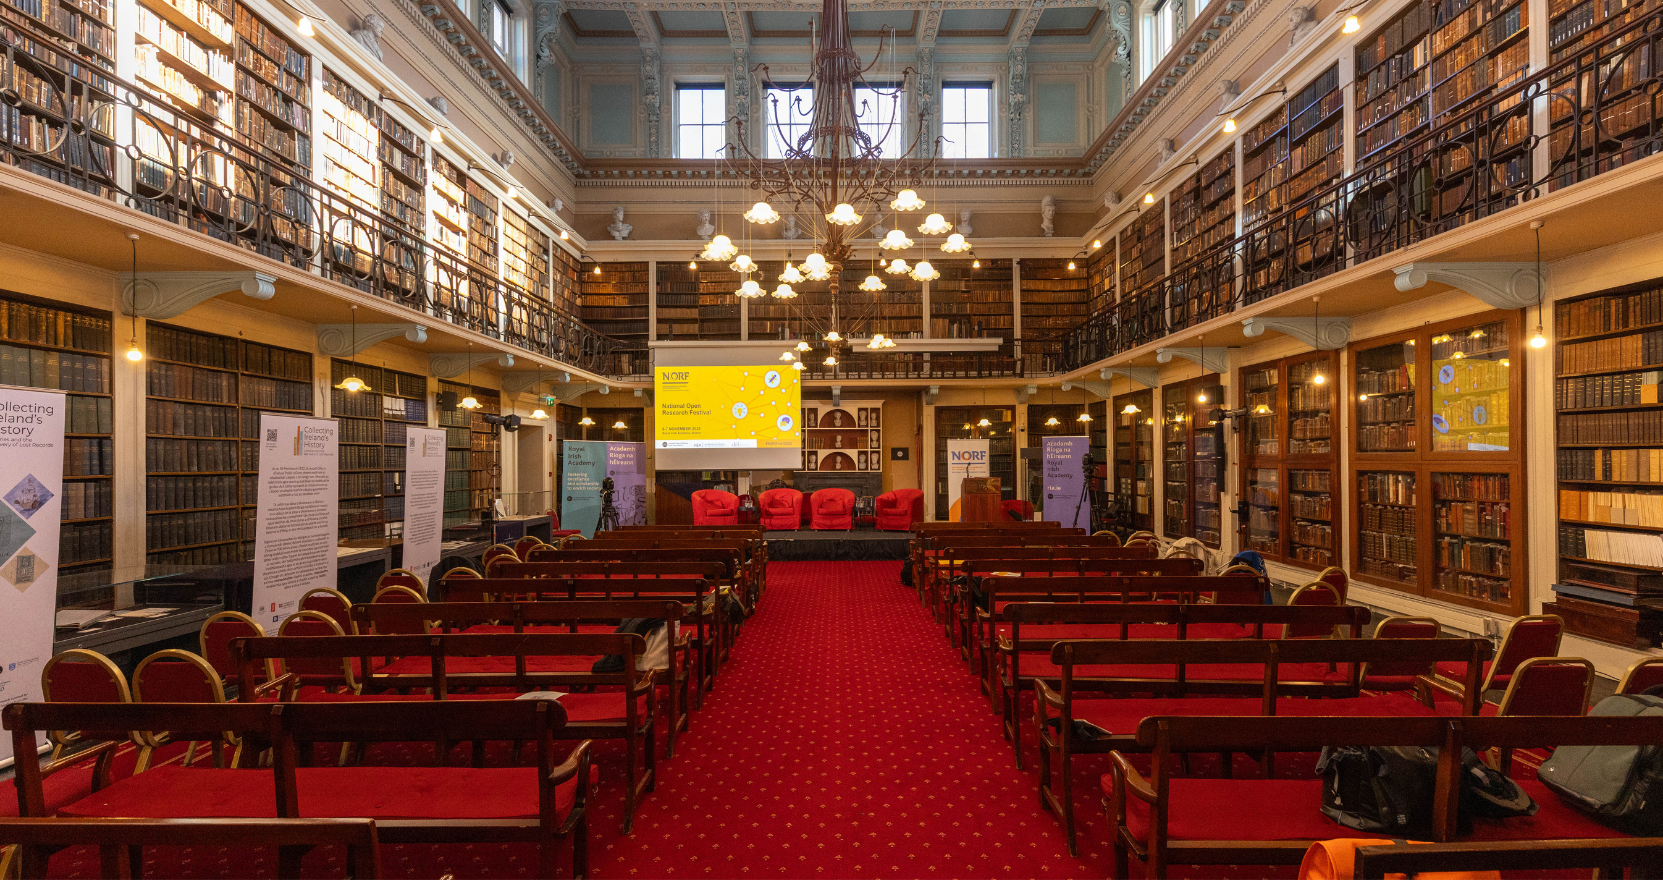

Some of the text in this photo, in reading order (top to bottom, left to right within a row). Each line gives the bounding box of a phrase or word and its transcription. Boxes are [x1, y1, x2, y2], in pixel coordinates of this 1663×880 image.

[662, 372, 689, 380] NORF
[0, 401, 54, 416] ollecting
[0, 425, 34, 437] story
[304, 426, 334, 436] Collecting
[304, 441, 325, 449] History
[951, 451, 986, 460] NORF
